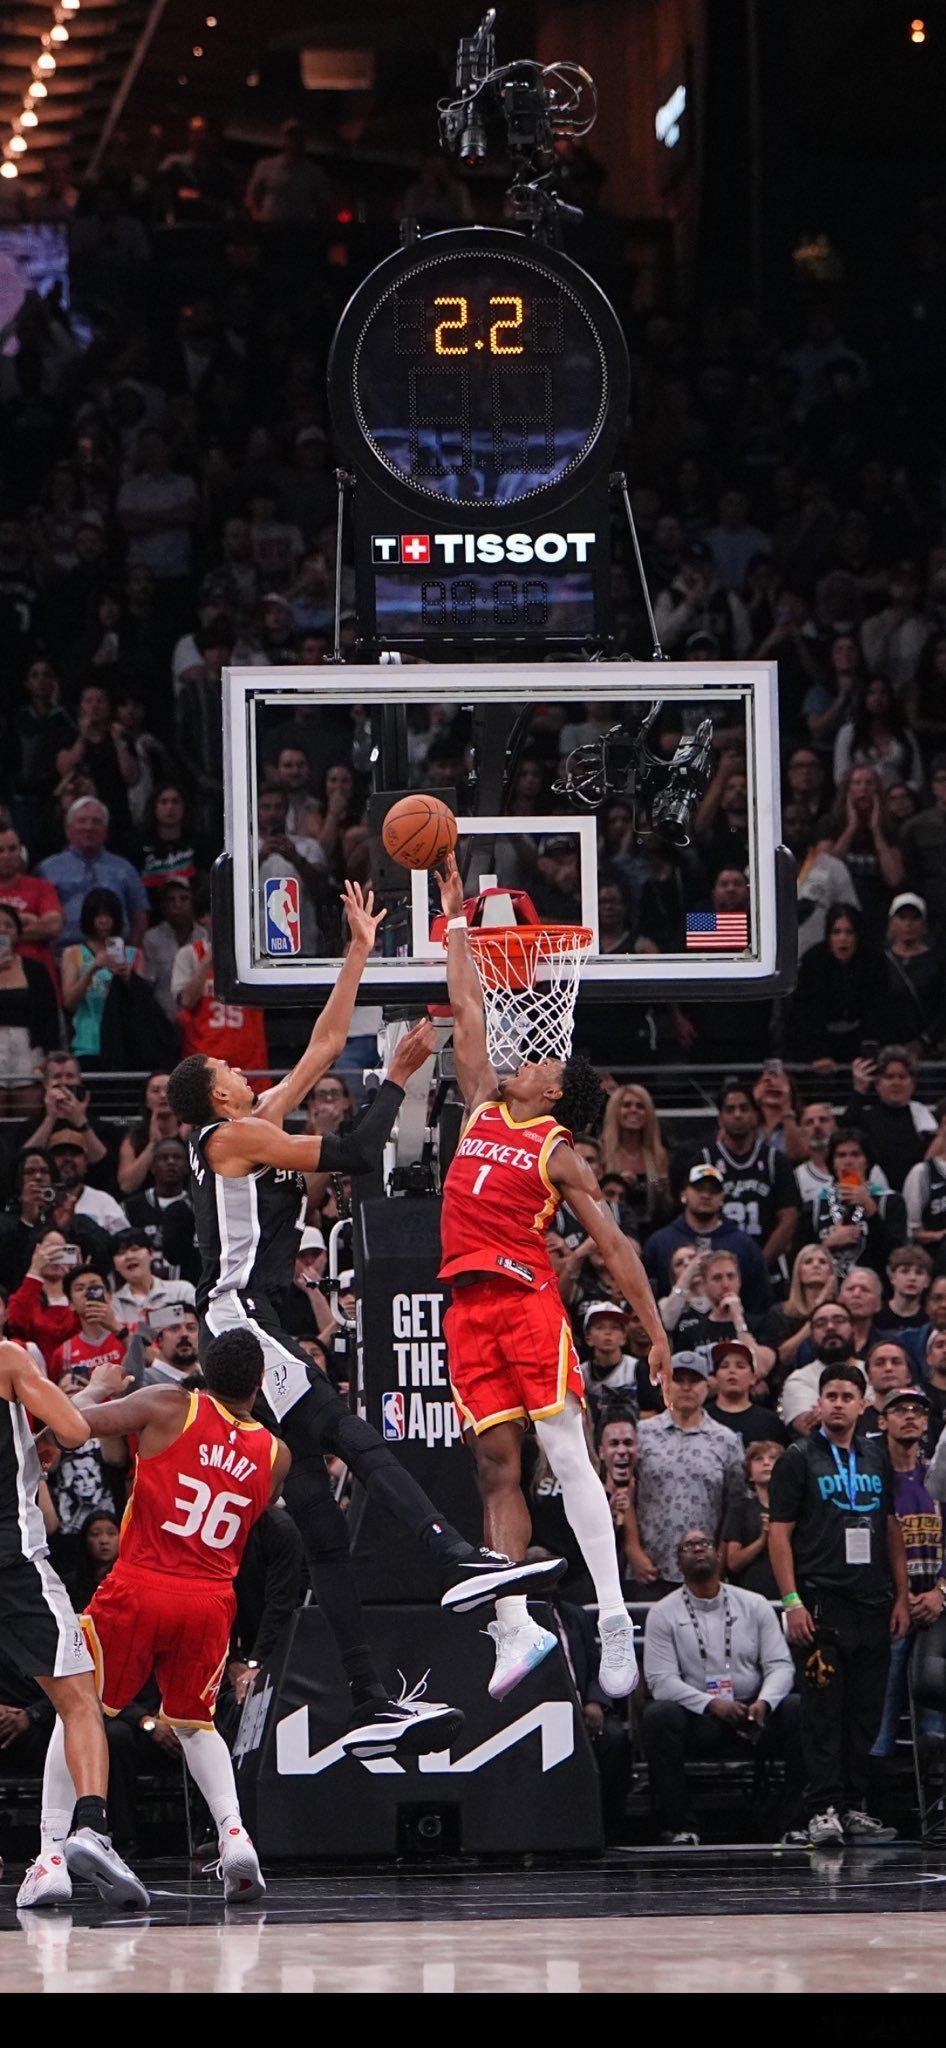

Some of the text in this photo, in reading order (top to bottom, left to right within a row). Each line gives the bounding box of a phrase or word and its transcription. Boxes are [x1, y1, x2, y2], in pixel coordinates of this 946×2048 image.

[434, 296, 524, 355] 2.2
[434, 532, 597, 564] TISSOT
[271, 937, 288, 950] NBA
[208, 1000, 245, 1028] 35
[457, 1137, 538, 1171] ROCKETS
[472, 1164, 492, 1195] 1
[722, 1200, 763, 1236] 91
[392, 1293, 444, 1338] GET
[392, 1342, 447, 1386] THE
[408, 1393, 461, 1448] App
[198, 1443, 258, 1482] SMART
[160, 1472, 252, 1550] 36
